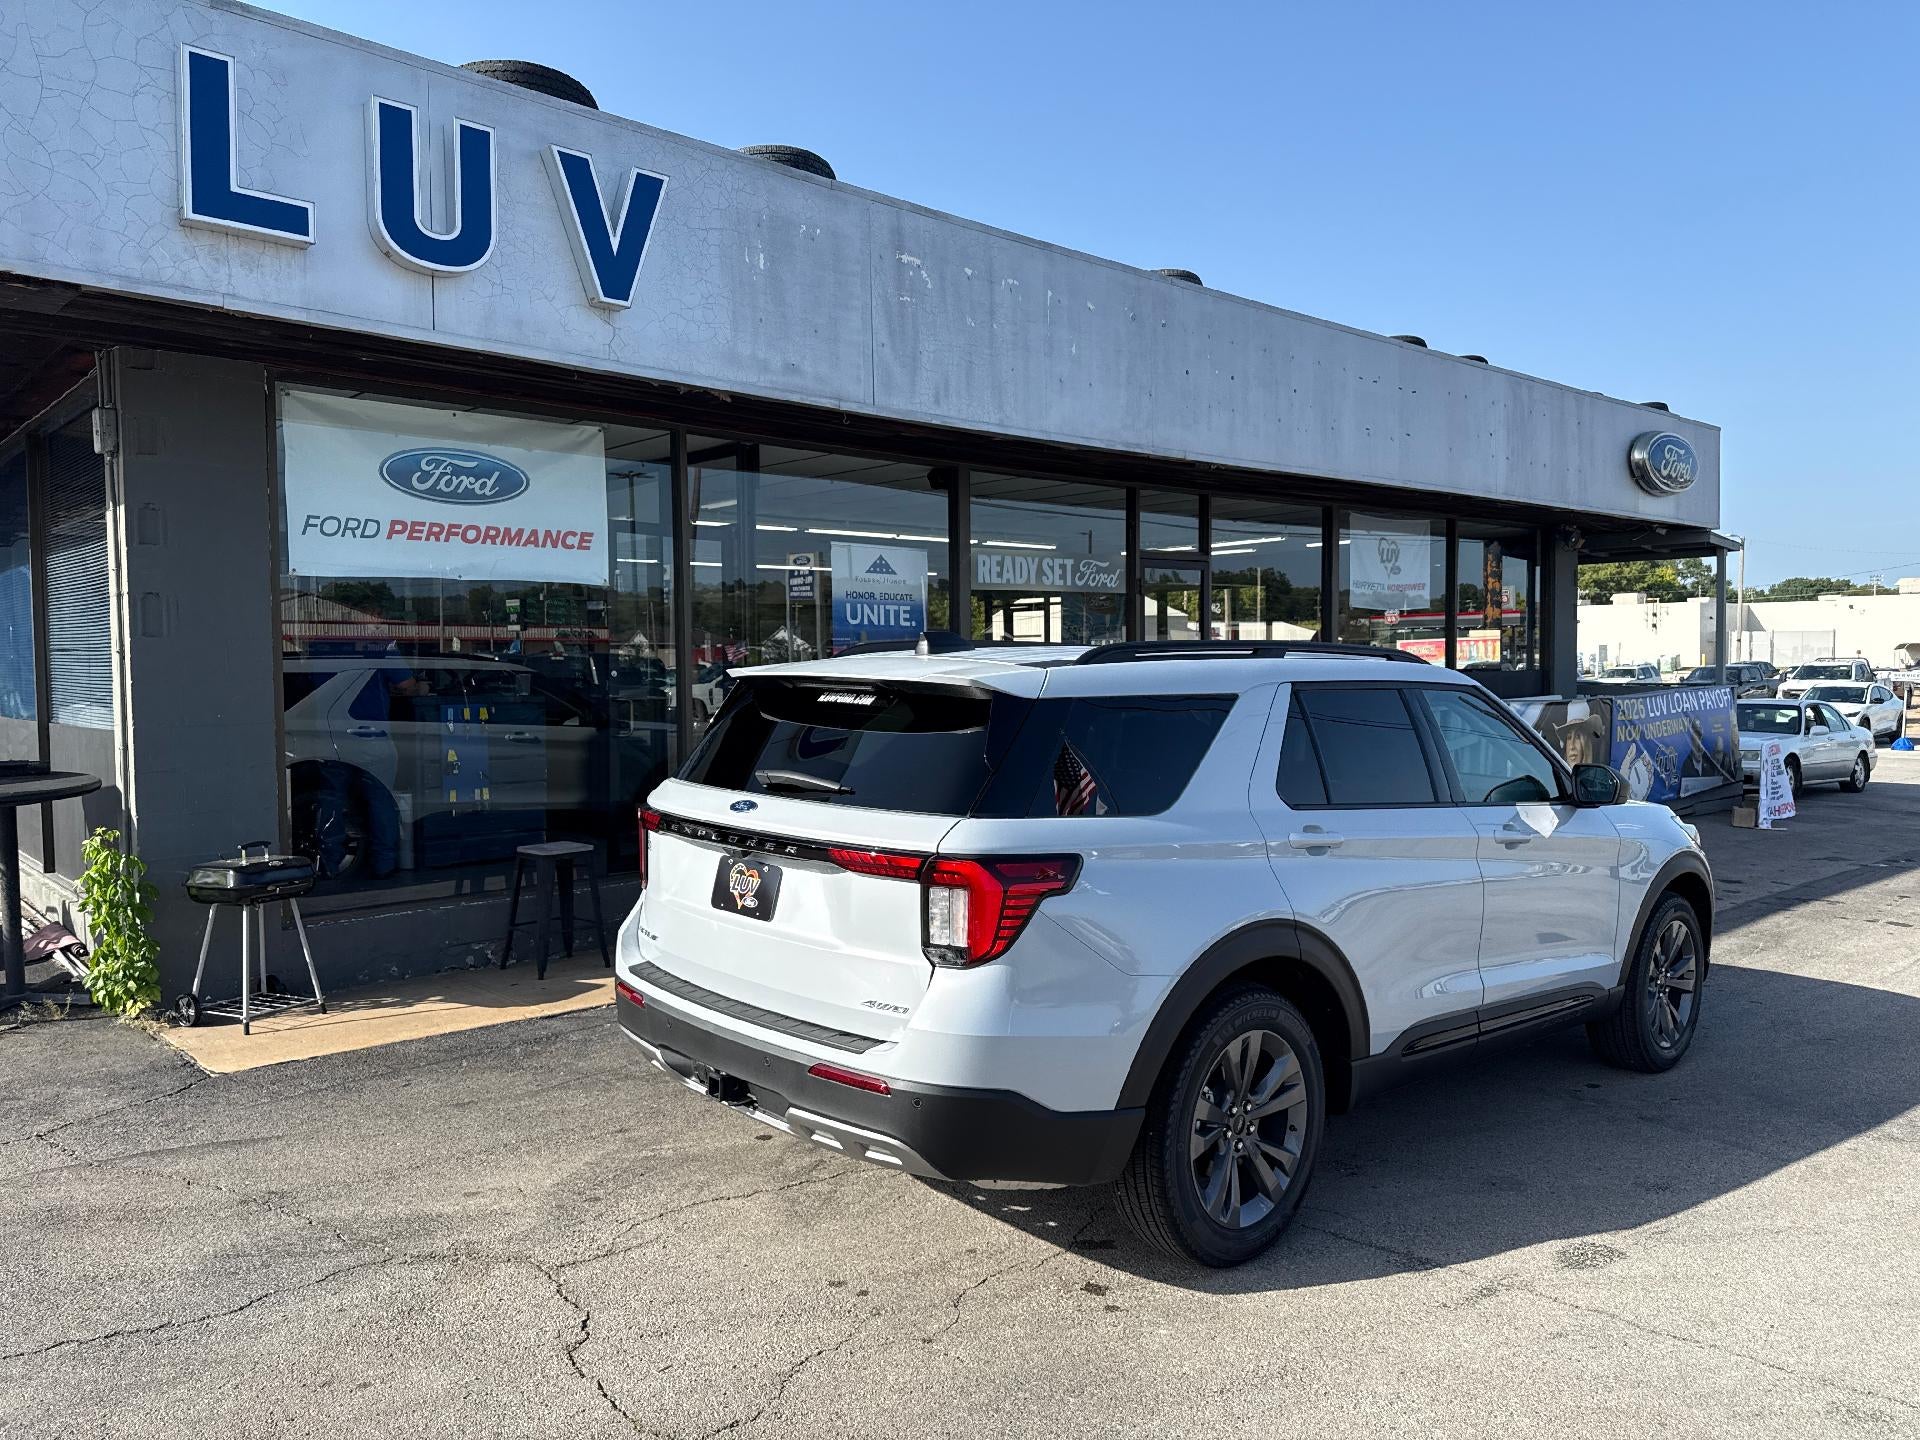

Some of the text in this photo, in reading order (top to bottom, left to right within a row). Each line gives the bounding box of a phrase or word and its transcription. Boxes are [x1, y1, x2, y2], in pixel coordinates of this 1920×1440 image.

[181, 42, 671, 309] LUV
[411, 454, 500, 497] Ford
[1660, 444, 1693, 481] Ford
[301, 514, 595, 551] FORD PERFORMANCE
[977, 554, 1121, 588] READY SET Ford
[846, 603, 916, 627] UNITE.
[1617, 698, 1646, 720] 2026
[1646, 694, 1667, 718] LUV
[1668, 691, 1699, 714] LOAN
[1616, 724, 1641, 742] NOW
[671, 823, 797, 854] EXPLORER
[730, 873, 761, 895] LUV
